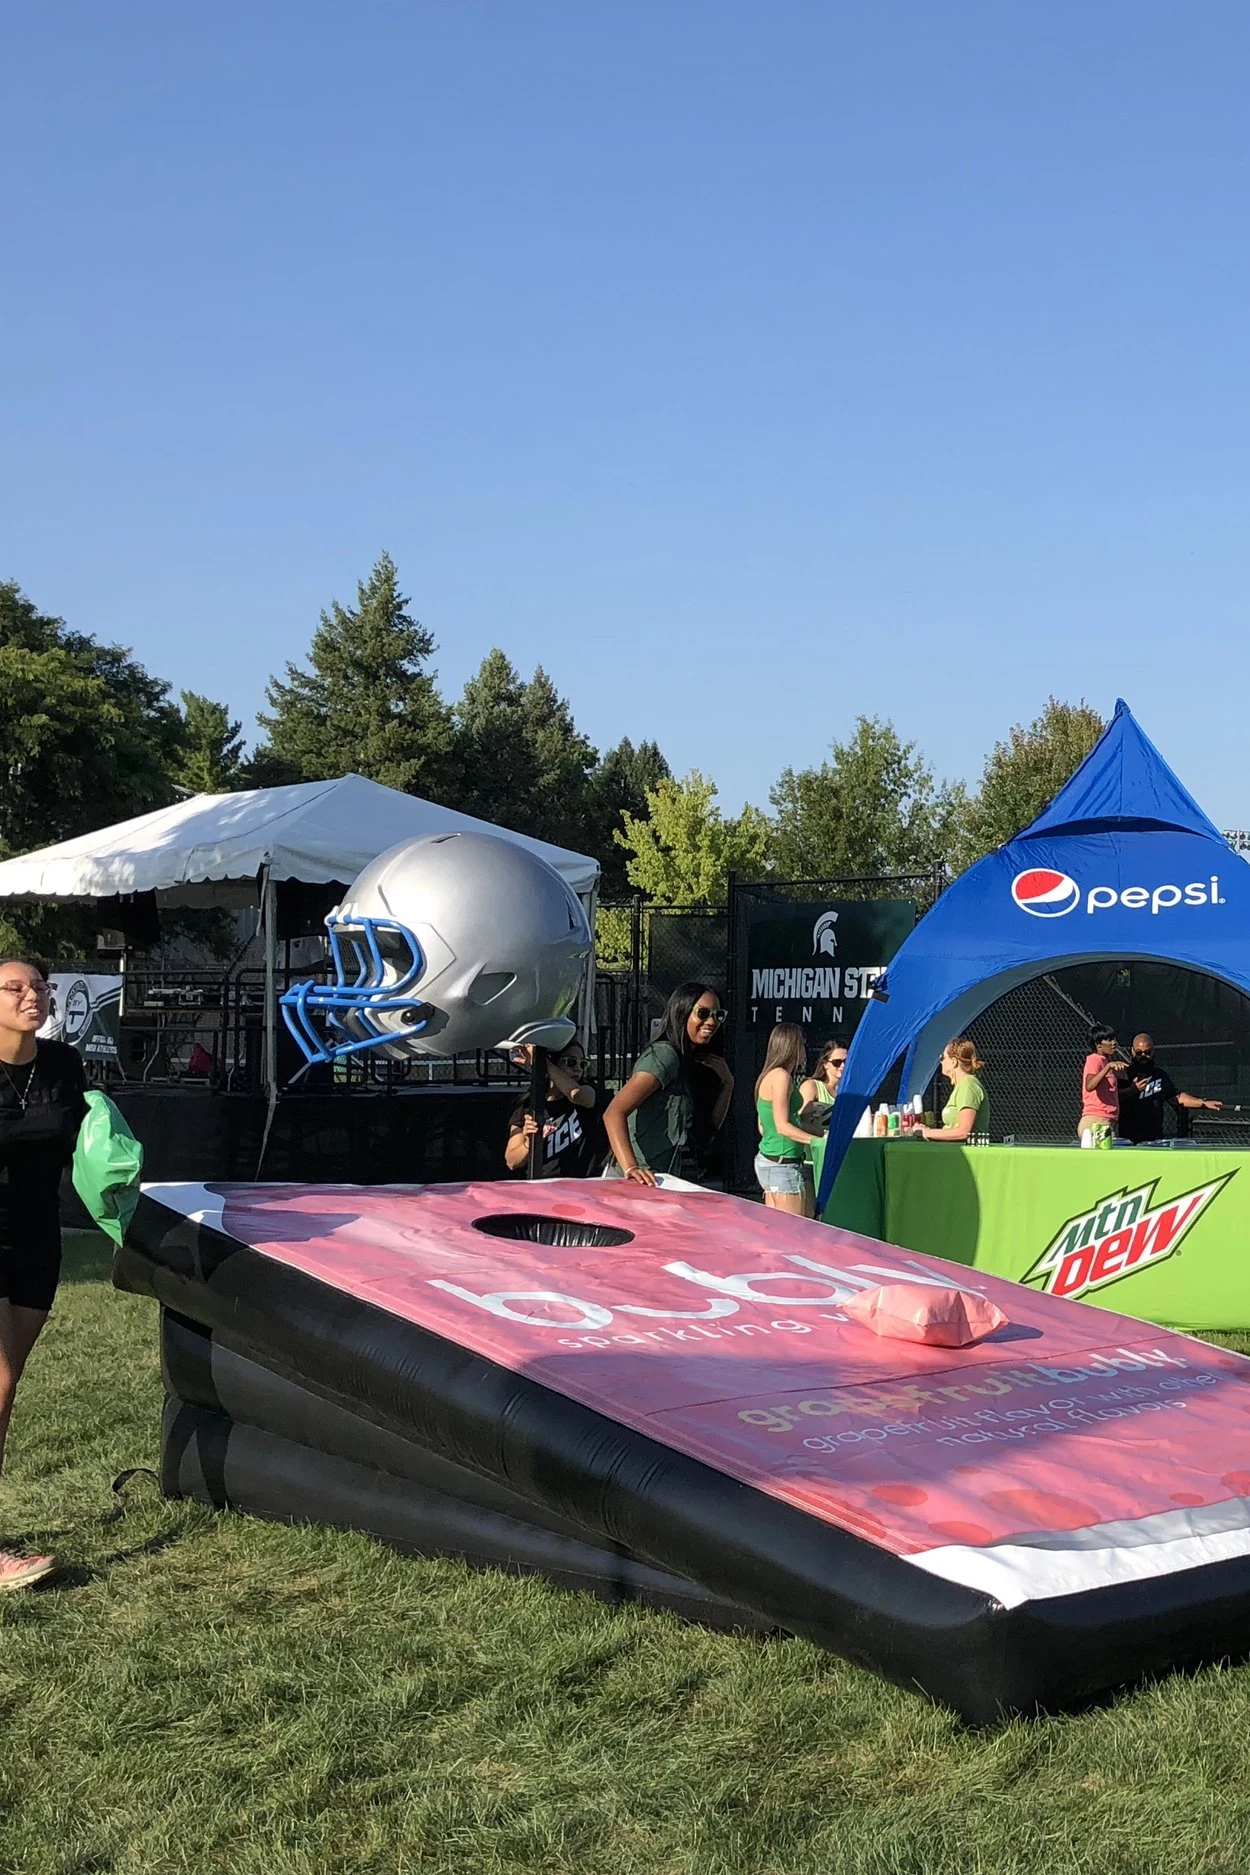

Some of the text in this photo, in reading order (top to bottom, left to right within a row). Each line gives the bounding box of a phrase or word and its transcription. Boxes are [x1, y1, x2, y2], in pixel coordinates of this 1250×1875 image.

[1086, 875, 1220, 915] pepsi
[750, 966, 888, 999] MICHIGAN ST
[557, 1318, 813, 1349] sparkling
[802, 1370, 1225, 1454] grapefruit flavor with other
[935, 1398, 1187, 1447] natural flavors
